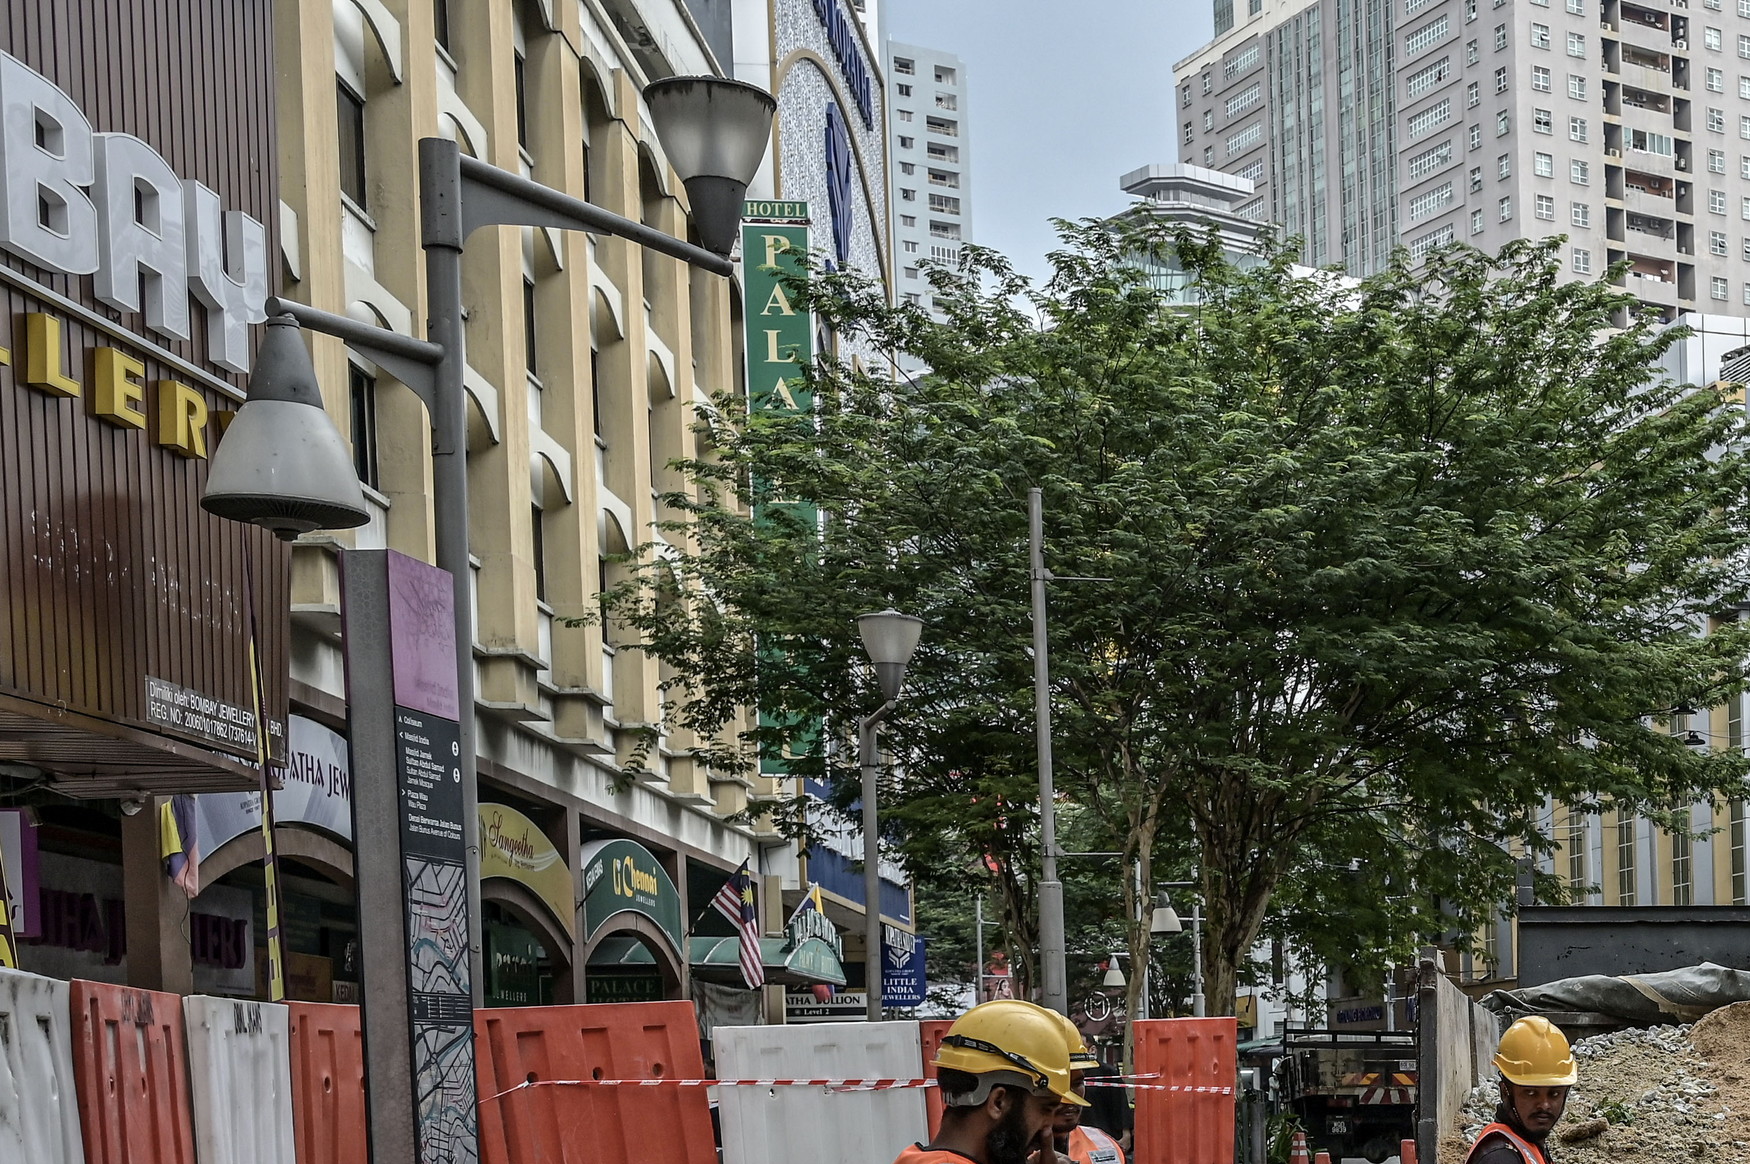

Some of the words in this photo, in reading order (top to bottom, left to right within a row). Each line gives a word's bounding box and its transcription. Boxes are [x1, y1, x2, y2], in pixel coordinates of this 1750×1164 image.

[746, 202, 804, 219] HOTEL
[149, 681, 173, 702] Dimiliki
[190, 694, 218, 716] BOMBAY
[218, 704, 256, 728] JEWELLERY
[270, 720, 283, 737] BHD.
[150, 701, 169, 721] REG.
[170, 708, 183, 725] NO:
[488, 811, 534, 867] Sangeetha
[591, 980, 656, 994] PALACE
[883, 977, 918, 986] LITTLE
[887, 986, 914, 994] INDIA
[804, 1008, 823, 1016] Level
[825, 1008, 830, 1016] 2
